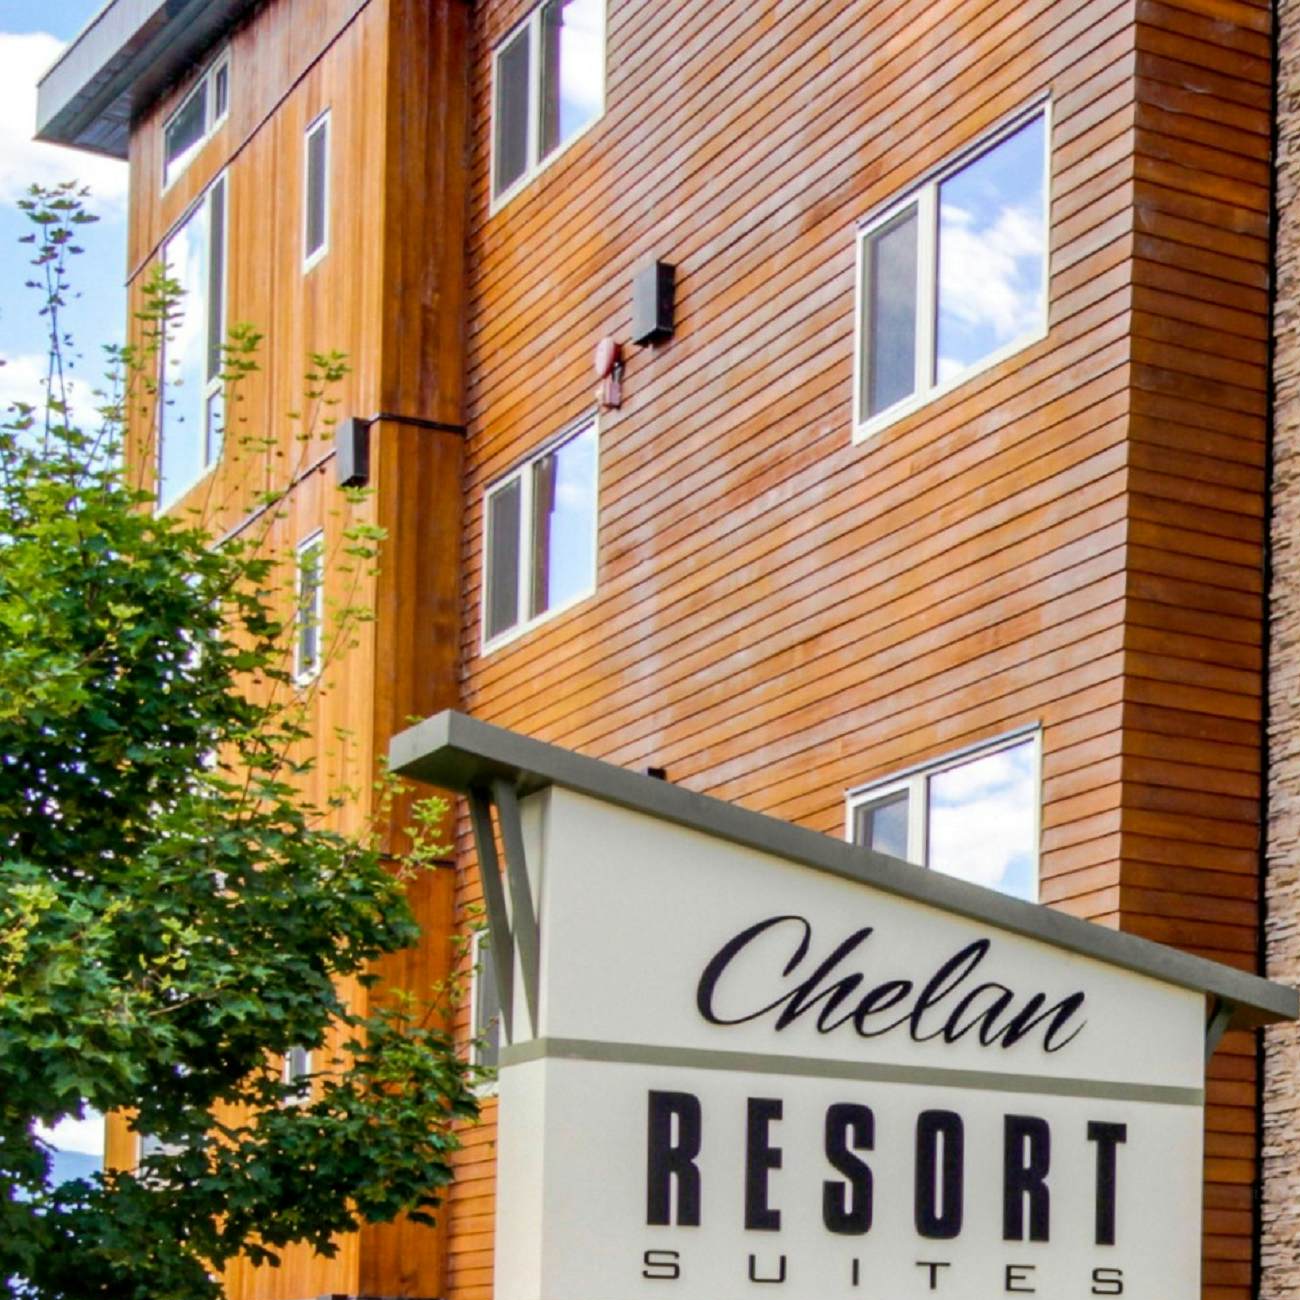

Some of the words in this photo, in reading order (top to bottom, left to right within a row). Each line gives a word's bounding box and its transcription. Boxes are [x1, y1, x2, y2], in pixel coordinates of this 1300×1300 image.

[696, 915, 1085, 1053] Chelan
[646, 1089, 1127, 1246] RESORT
[642, 1249, 1124, 1296] SUITES
